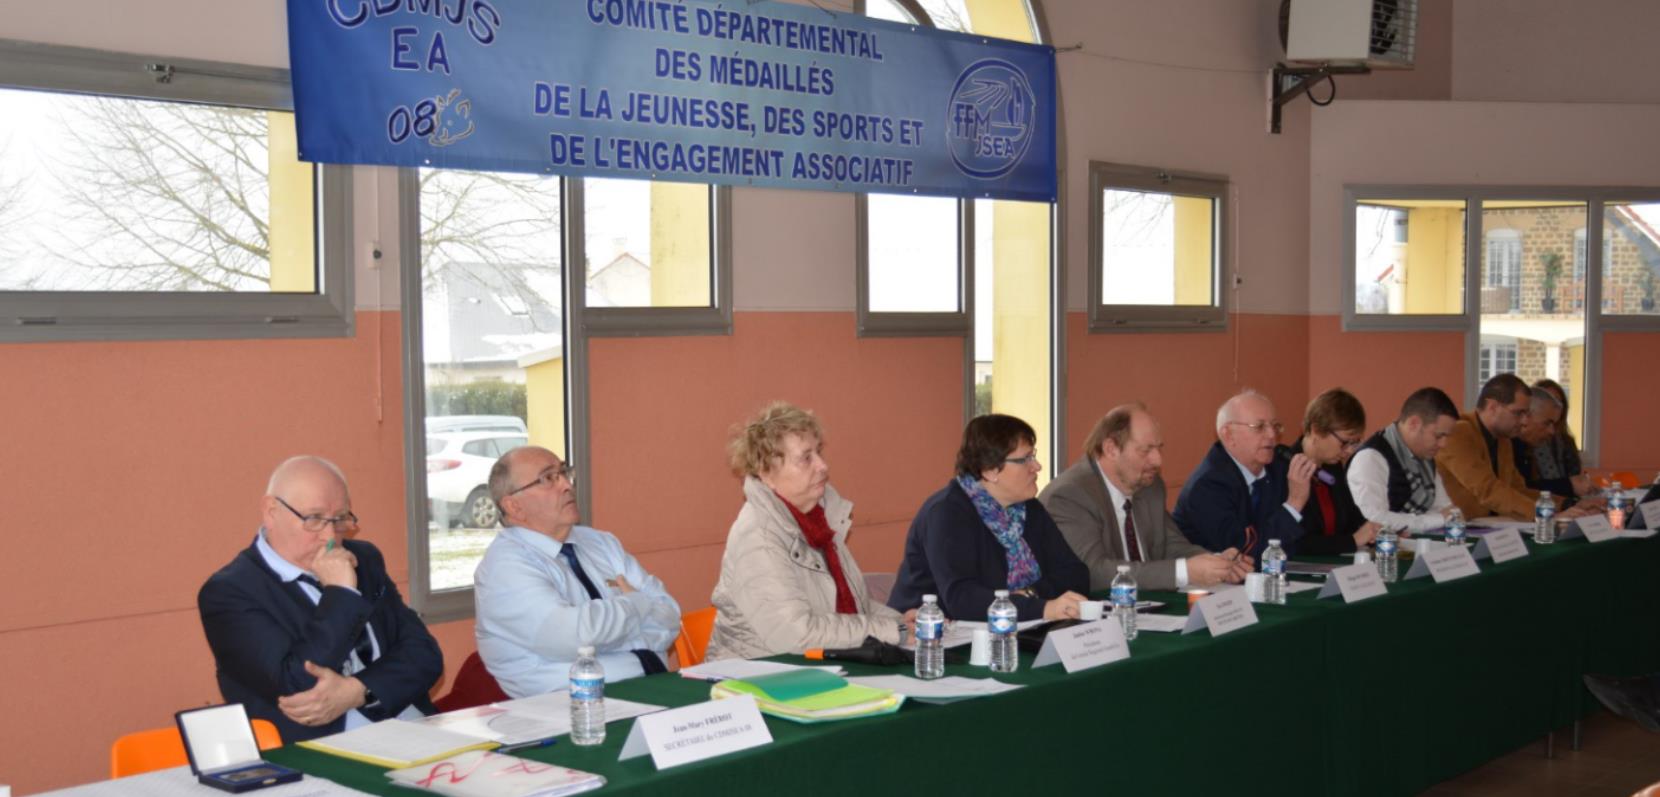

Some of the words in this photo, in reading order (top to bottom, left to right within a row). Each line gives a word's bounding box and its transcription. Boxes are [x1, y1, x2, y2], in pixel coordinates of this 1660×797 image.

[585, 0, 690, 34] COMITÉ
[696, 3, 884, 61] DÉPARTEMENTAL
[655, 47, 702, 82] DES
[709, 50, 835, 97] MÉDAILLÉS
[387, 99, 438, 144] 08
[534, 83, 570, 116] DE
[579, 87, 613, 119] LA
[621, 92, 757, 138] JEUNESSE,
[764, 105, 806, 137] DES
[813, 110, 894, 144] SPORTS
[900, 119, 923, 147] ET
[550, 133, 585, 166] DE
[594, 137, 784, 178] L'ENGAGEMENT
[791, 151, 914, 186] ASSOCIATIF
[975, 135, 1015, 157] JSEA
